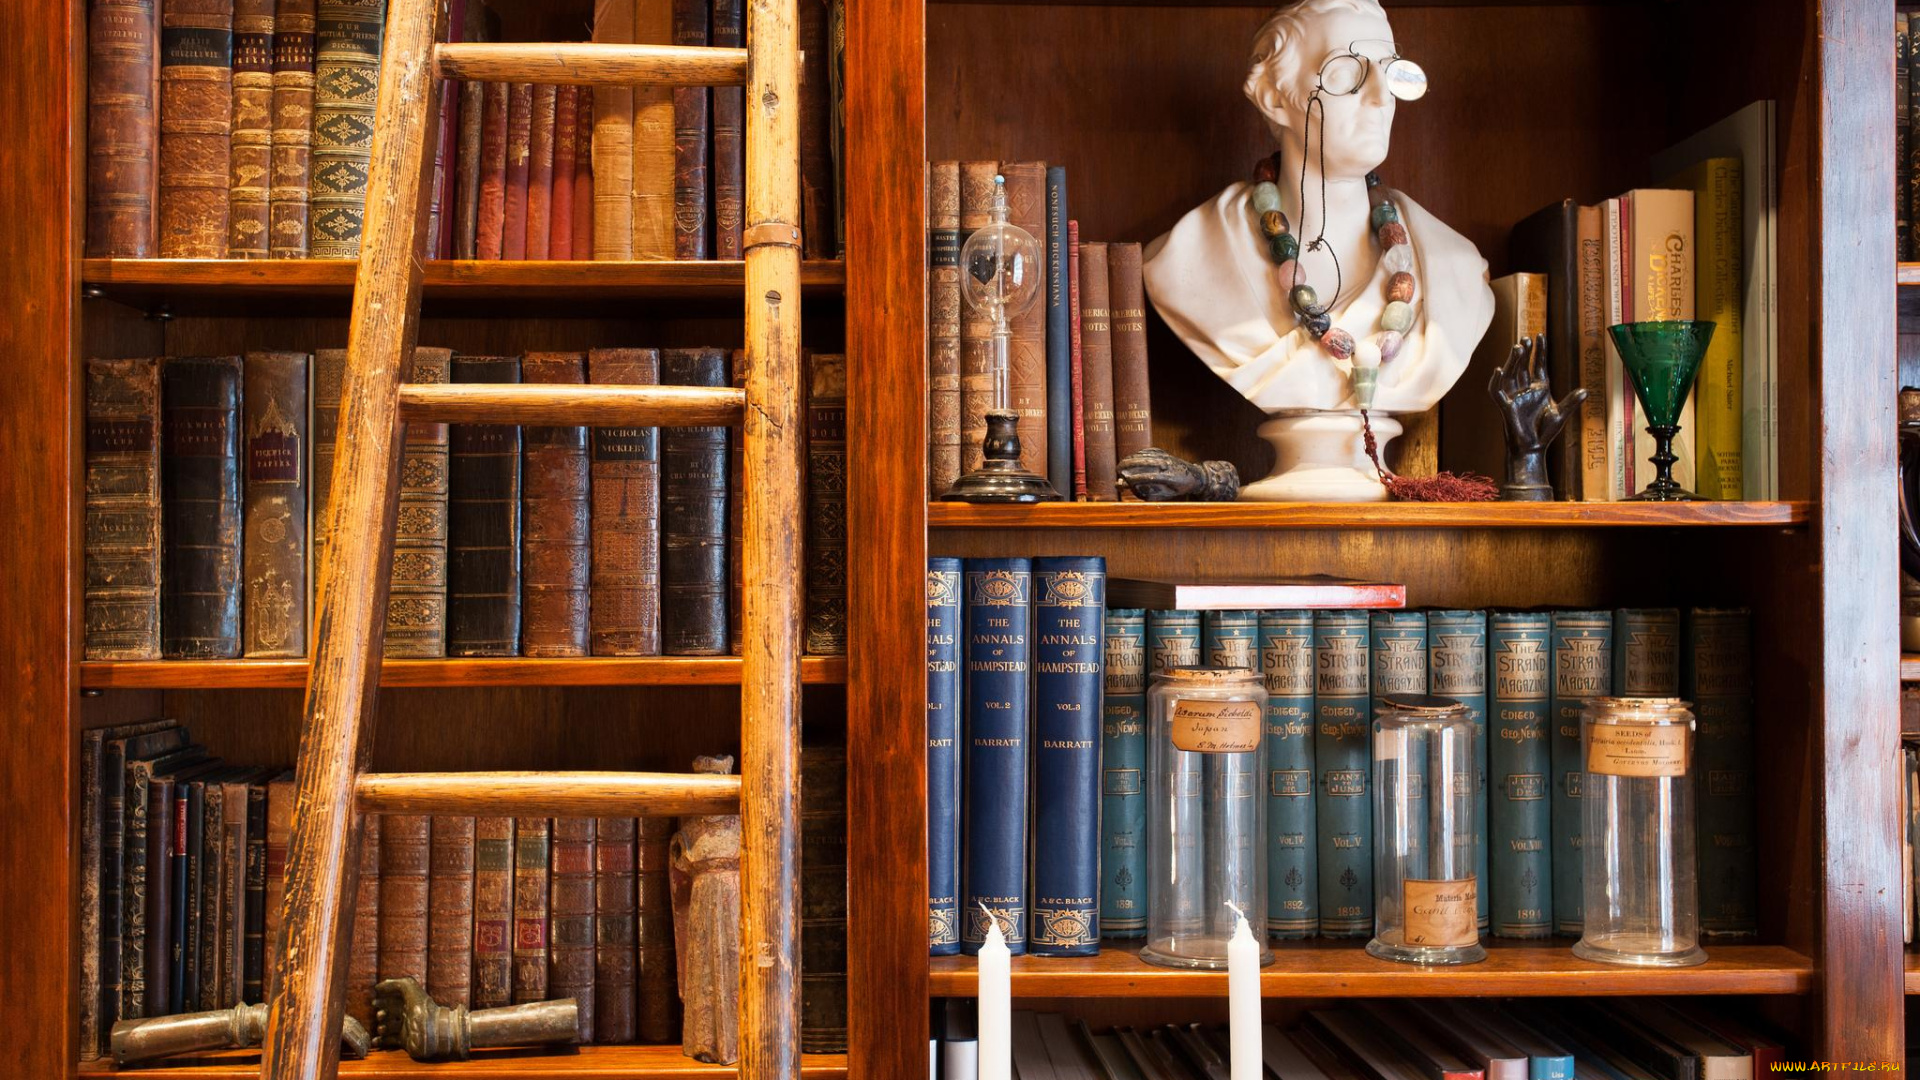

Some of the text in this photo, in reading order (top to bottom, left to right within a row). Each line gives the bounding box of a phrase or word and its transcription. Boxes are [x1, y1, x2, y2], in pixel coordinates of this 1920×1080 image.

[338, 23, 360, 31] OUR
[1610, 208, 1619, 261] CATALOGUE
[726, 236, 734, 249] 2
[1051, 184, 1060, 308] NONESUCH DICKENSIANA
[1664, 233, 1684, 318] CHARLES
[1612, 264, 1620, 303] DICKENS
[1084, 322, 1109, 332] NOTES
[1116, 322, 1143, 332] NOTES
[1726, 359, 1734, 388] Michael
[1094, 402, 1104, 410] BY
[600, 428, 651, 438] NICHOLAS
[255, 449, 292, 457] PICKWICK
[601, 444, 646, 453] NICKLEBY
[256, 460, 291, 468] PAPERS
[928, 618, 941, 627] HE
[987, 618, 1010, 627] THE
[1057, 618, 1081, 628] THE
[928, 634, 954, 645] ALS
[973, 634, 1025, 645] ANNALS
[1041, 635, 1097, 645] ANNALS
[1111, 638, 1133, 650] THE
[1277, 639, 1300, 650] THE
[1391, 641, 1413, 653] THE
[1512, 643, 1535, 654] THE
[1573, 641, 1596, 652] THE
[1154, 650, 1200, 668] STRAND
[1264, 651, 1313, 669] STRAND
[1319, 651, 1367, 669] STRAND
[1377, 653, 1426, 671] STRAND
[1560, 653, 1610, 672] STRAND
[1629, 648, 1675, 668] SRAND
[928, 661, 956, 672] STEAD
[970, 661, 1027, 672] HAMPSTEAD
[1037, 662, 1100, 674] HAMPSTEAD
[1499, 656, 1547, 673] STRAND
[1105, 673, 1144, 688] AGAZINE
[1265, 672, 1313, 691] MAGAZINE
[1318, 672, 1368, 691] MAGAZINE
[1377, 674, 1427, 694] MAGAZINE
[1498, 676, 1547, 695] MAGAZINE
[1558, 674, 1611, 694] MAGAZINE
[1267, 705, 1300, 716] EDITED
[1320, 705, 1355, 716] EDITED
[1501, 709, 1535, 720] EDITED
[1191, 722, 1229, 736] Japan
[1615, 730, 1643, 738] SEEDS
[974, 738, 1022, 747] BARRATT
[1043, 740, 1094, 749] BARRATT
[1280, 773, 1300, 782] JULY
[1511, 777, 1542, 786] JULY
[1331, 784, 1363, 793] JUNE
[993, 896, 1020, 904] BLACK
[1435, 894, 1463, 903] Materia
